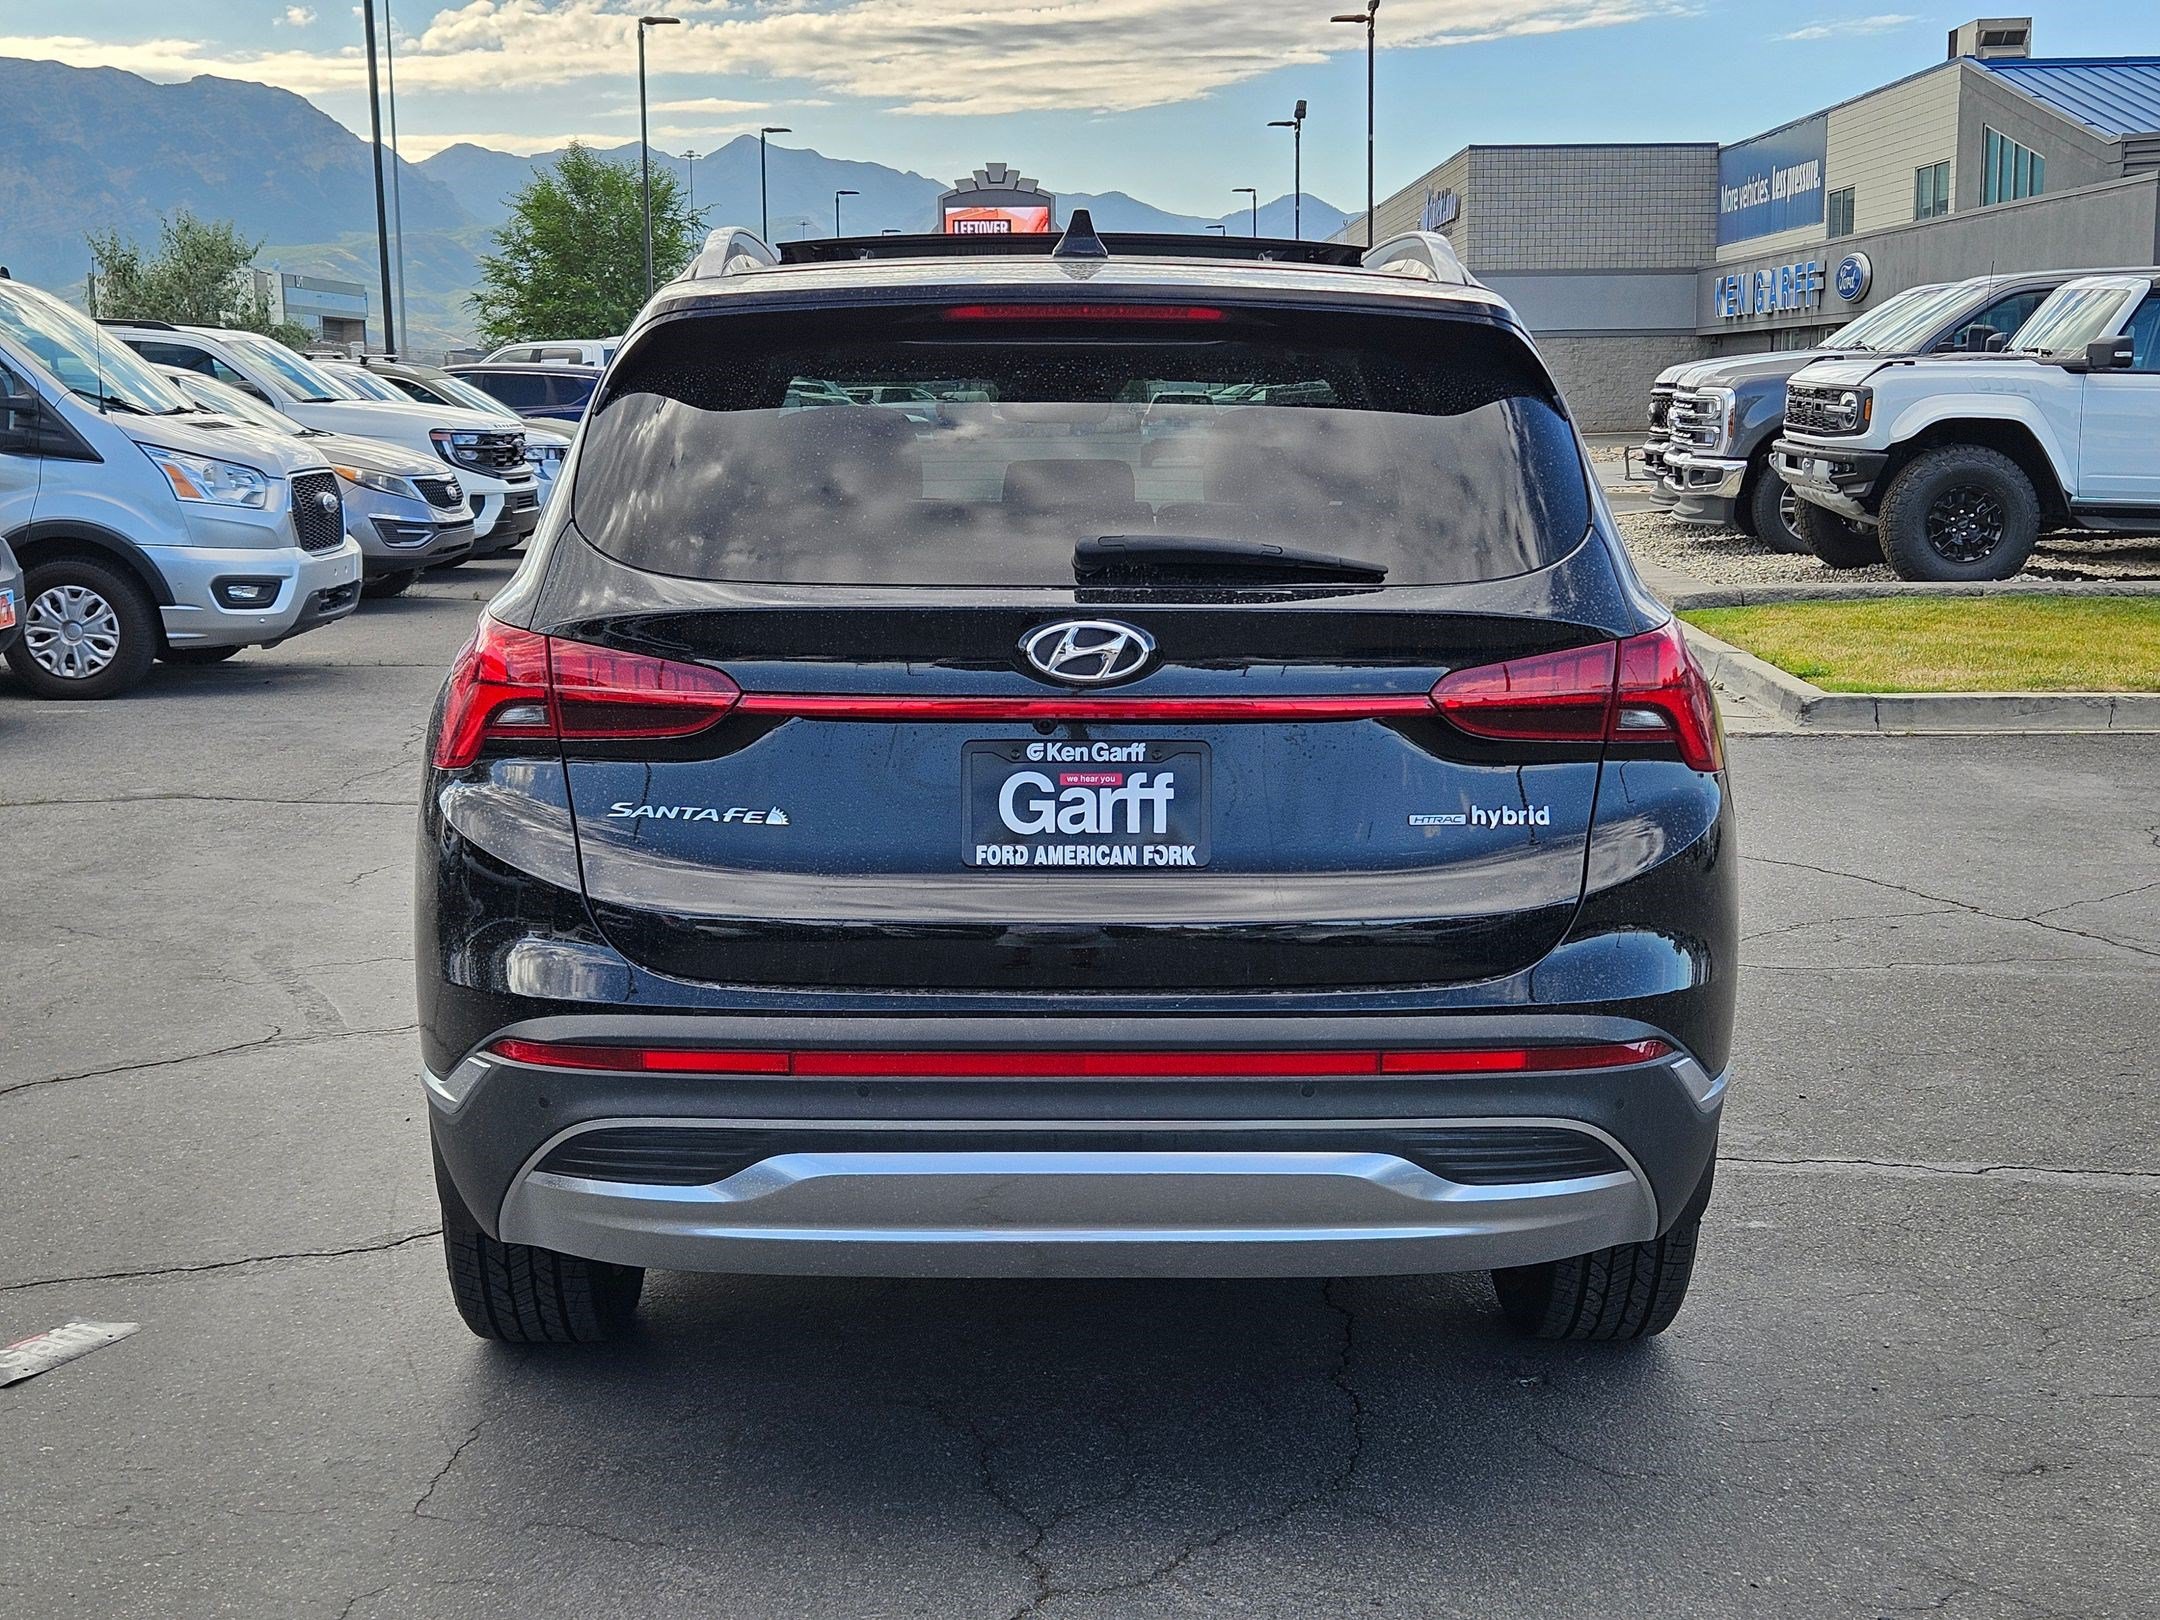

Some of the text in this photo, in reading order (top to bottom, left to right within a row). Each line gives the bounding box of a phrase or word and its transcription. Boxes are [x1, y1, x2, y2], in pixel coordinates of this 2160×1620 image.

[1721, 159, 1821, 214] More vehicles. Less pressure.
[954, 221, 1008, 234] LEFTOVER
[1716, 260, 1819, 318] KEN GARFF
[1838, 265, 1856, 291] Ford
[1046, 742, 1146, 761] Ken Garff
[1080, 775, 1099, 783] hear
[1100, 776, 1116, 785] you
[607, 802, 766, 824] SANTA FE
[999, 771, 1174, 834] Garff
[1414, 805, 1550, 829] HTRAC hybrid
[976, 845, 1196, 866] FORD AMERICAN FORK
